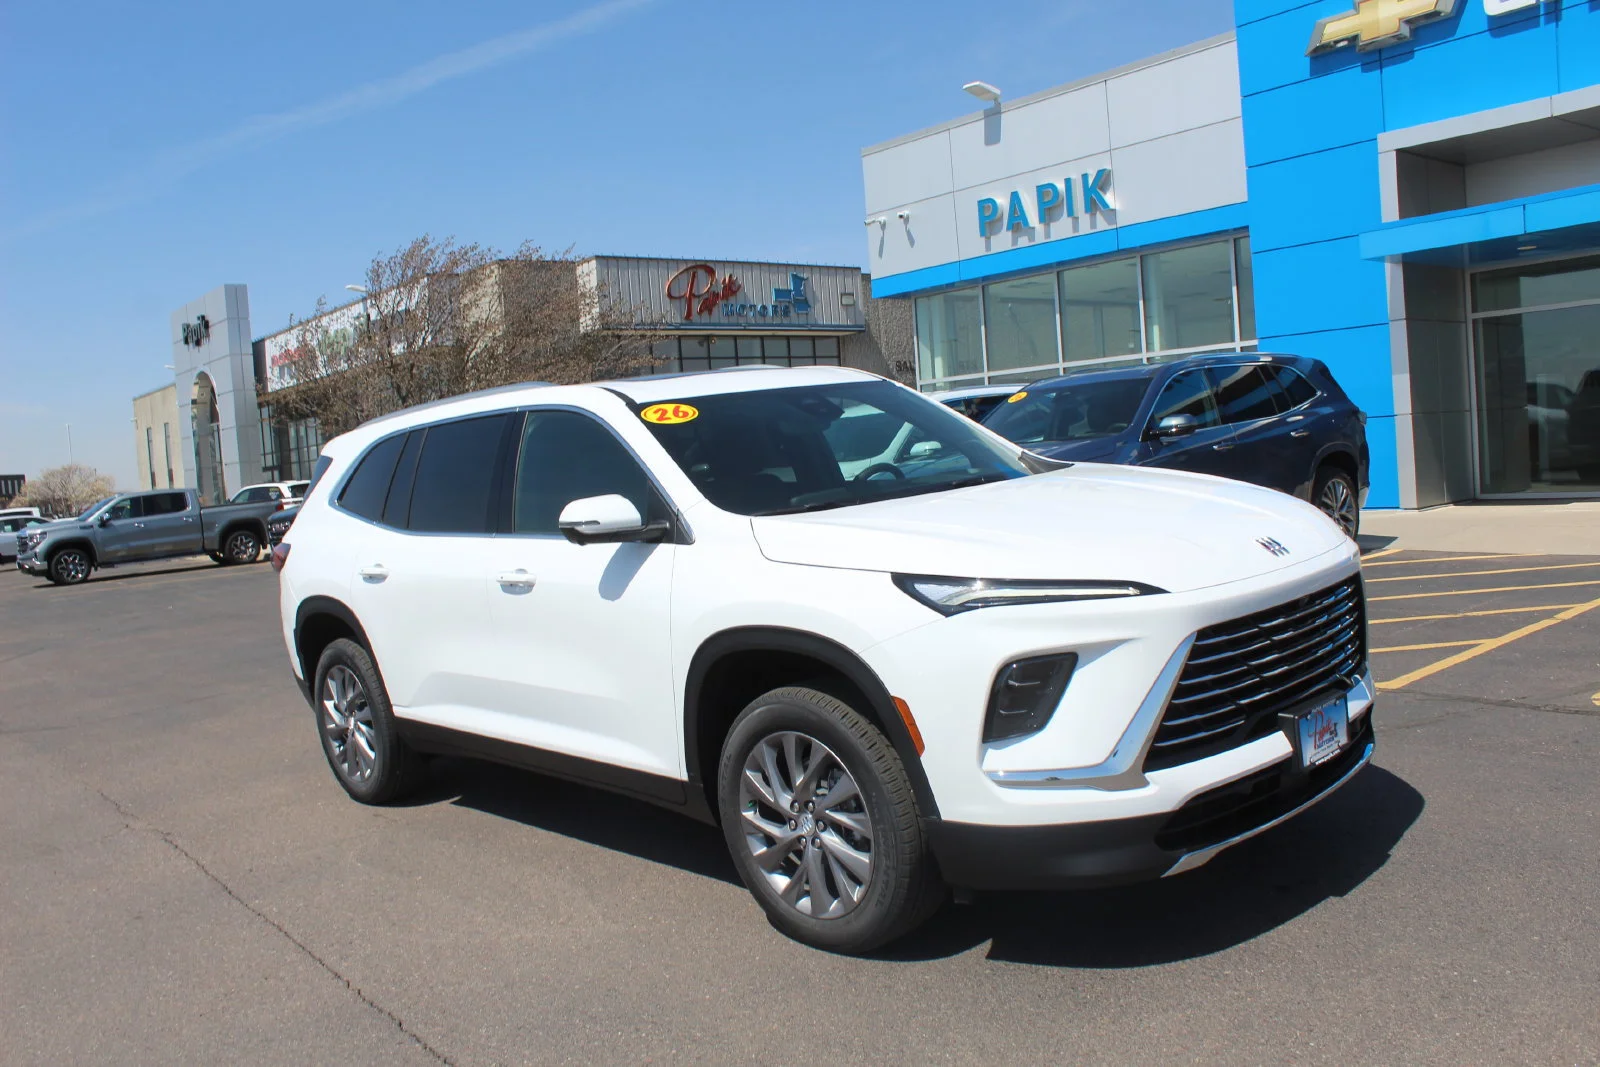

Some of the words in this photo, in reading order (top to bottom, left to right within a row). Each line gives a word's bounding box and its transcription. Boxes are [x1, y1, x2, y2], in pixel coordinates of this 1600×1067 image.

[977, 168, 1111, 237] PAPIK
[722, 303, 791, 317] MOTORS
[653, 406, 689, 421] 26
